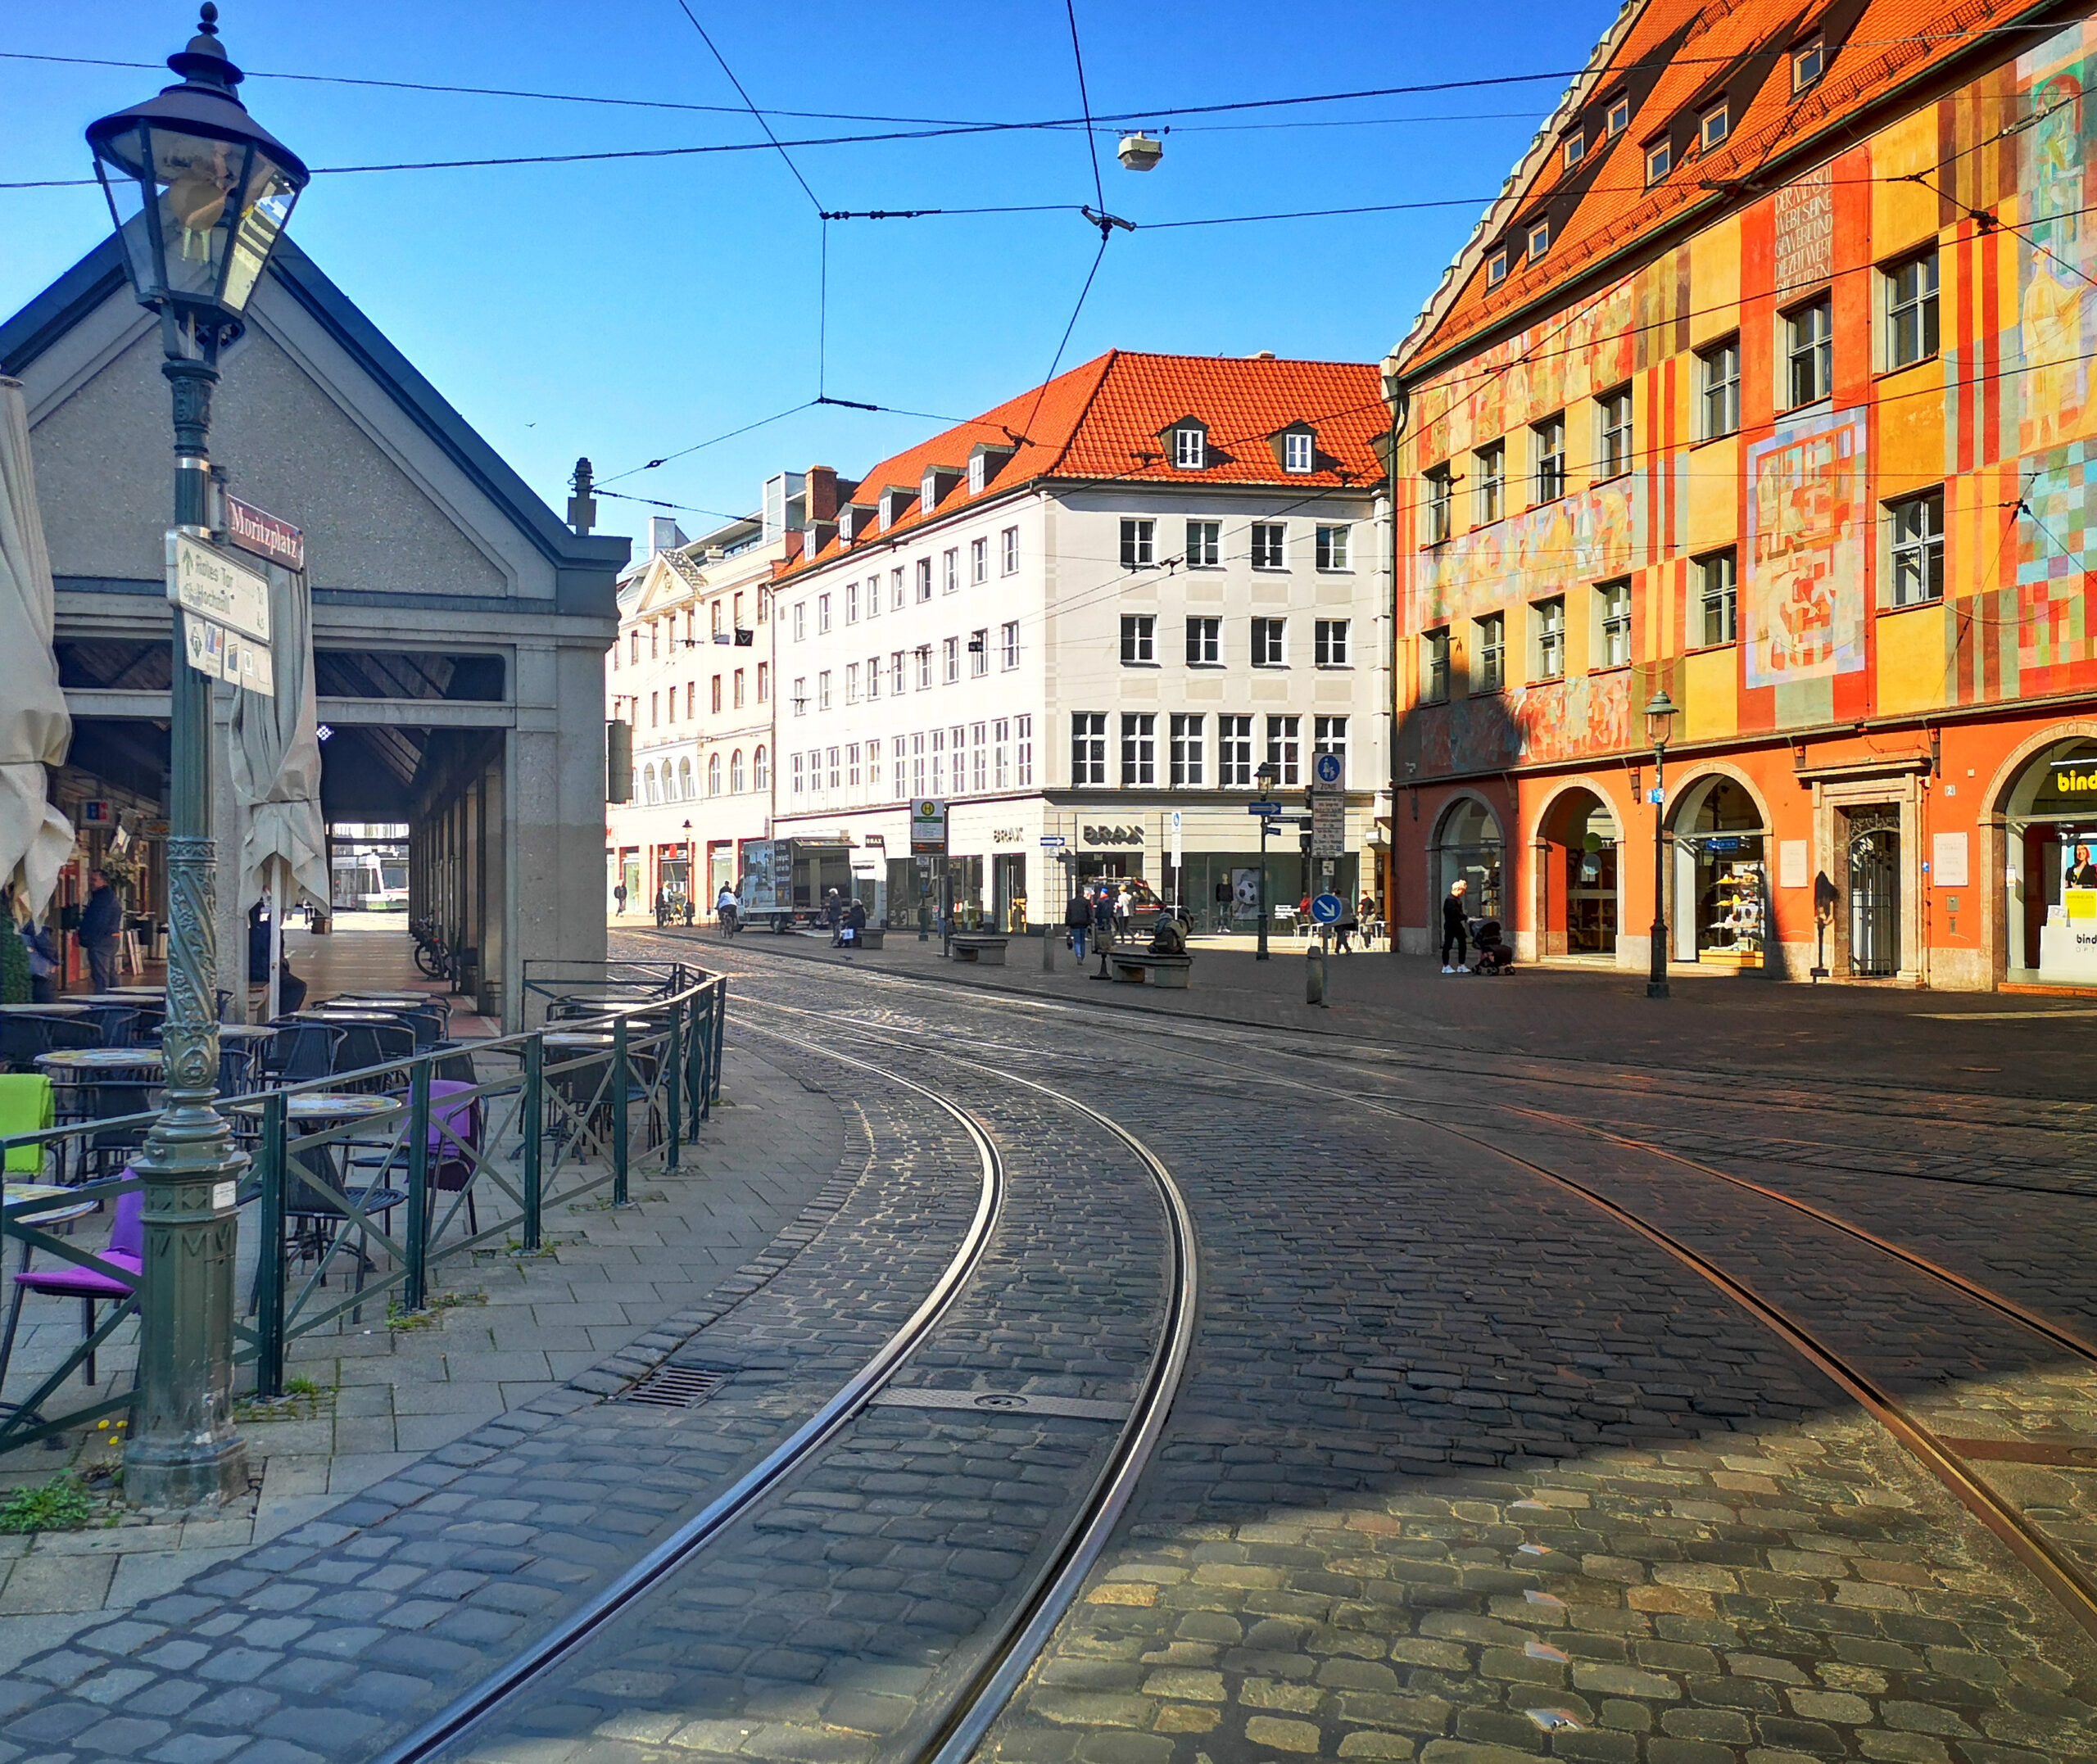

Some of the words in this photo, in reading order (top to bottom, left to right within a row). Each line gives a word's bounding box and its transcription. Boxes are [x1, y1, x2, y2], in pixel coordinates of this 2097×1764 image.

[1774, 188, 1793, 215] DER
[1774, 206, 1801, 237] WEBT
[1802, 189, 1832, 221] SEINE
[1774, 259, 1788, 283] DIE
[1788, 247, 1806, 276] ZEIT
[1806, 235, 1833, 267] WEBT
[229, 501, 297, 559] Moritzplatz
[1320, 783, 1337, 791] ZONE
[1947, 786, 1954, 795] 2
[2057, 769, 2097, 793] bind
[993, 827, 1024, 844] BRAX
[1083, 825, 1144, 845] BRAX
[2076, 934, 2097, 945] bind
